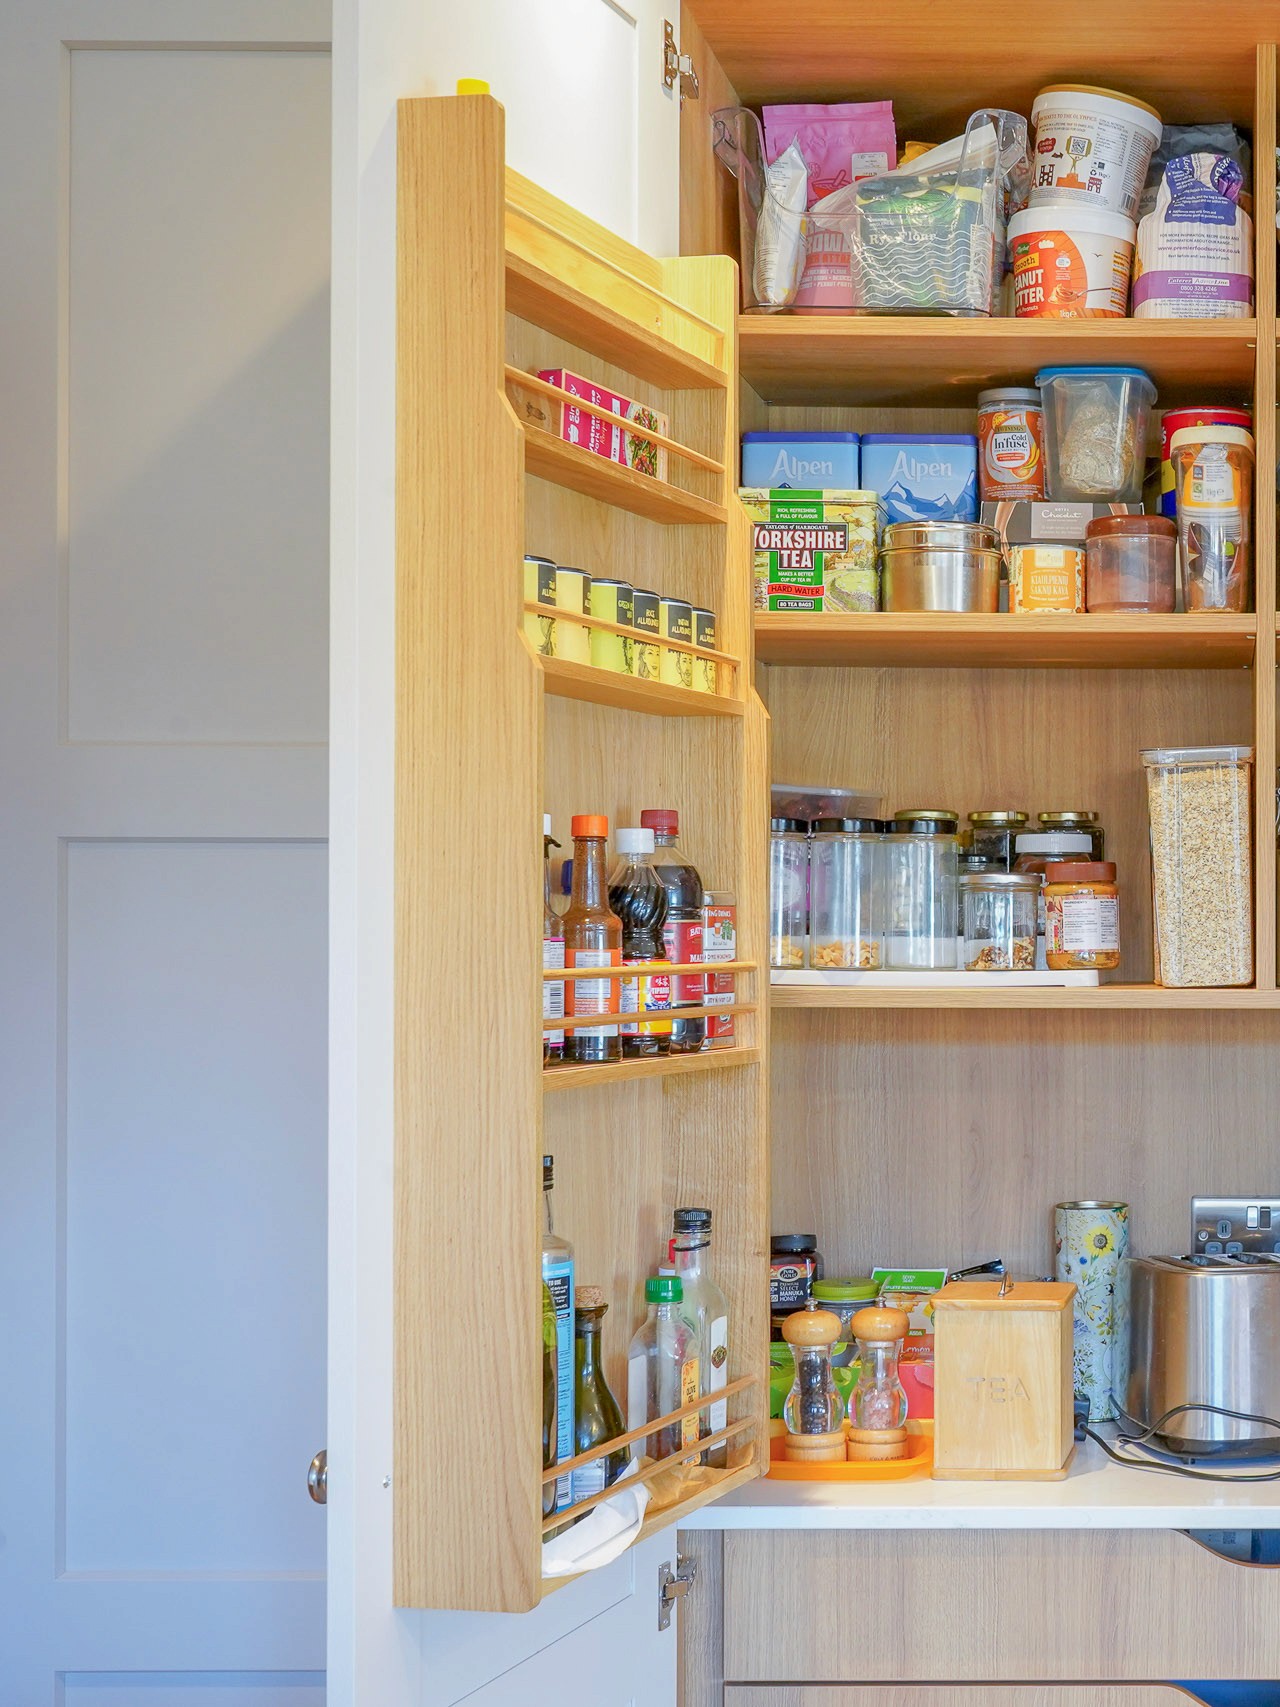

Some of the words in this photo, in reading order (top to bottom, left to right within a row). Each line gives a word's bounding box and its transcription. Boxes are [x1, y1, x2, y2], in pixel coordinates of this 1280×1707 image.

[870, 234, 892, 245] Rye
[899, 231, 937, 242] Flour
[1158, 246, 1240, 254] www.premierfoodservice.co.uk
[1015, 269, 1044, 291] EANUT
[1016, 286, 1044, 308] UTTER
[769, 449, 833, 482] Alpen
[888, 450, 952, 482] Alpen
[754, 526, 845, 548] YORKSHIRE
[781, 550, 812, 568] TEA
[1053, 586, 1068, 595] KAVA
[690, 954, 703, 962] MAL
[901, 1345, 930, 1354] Lemon
[686, 1385, 696, 1396] OLIVE
[966, 1377, 1031, 1403] TEA
